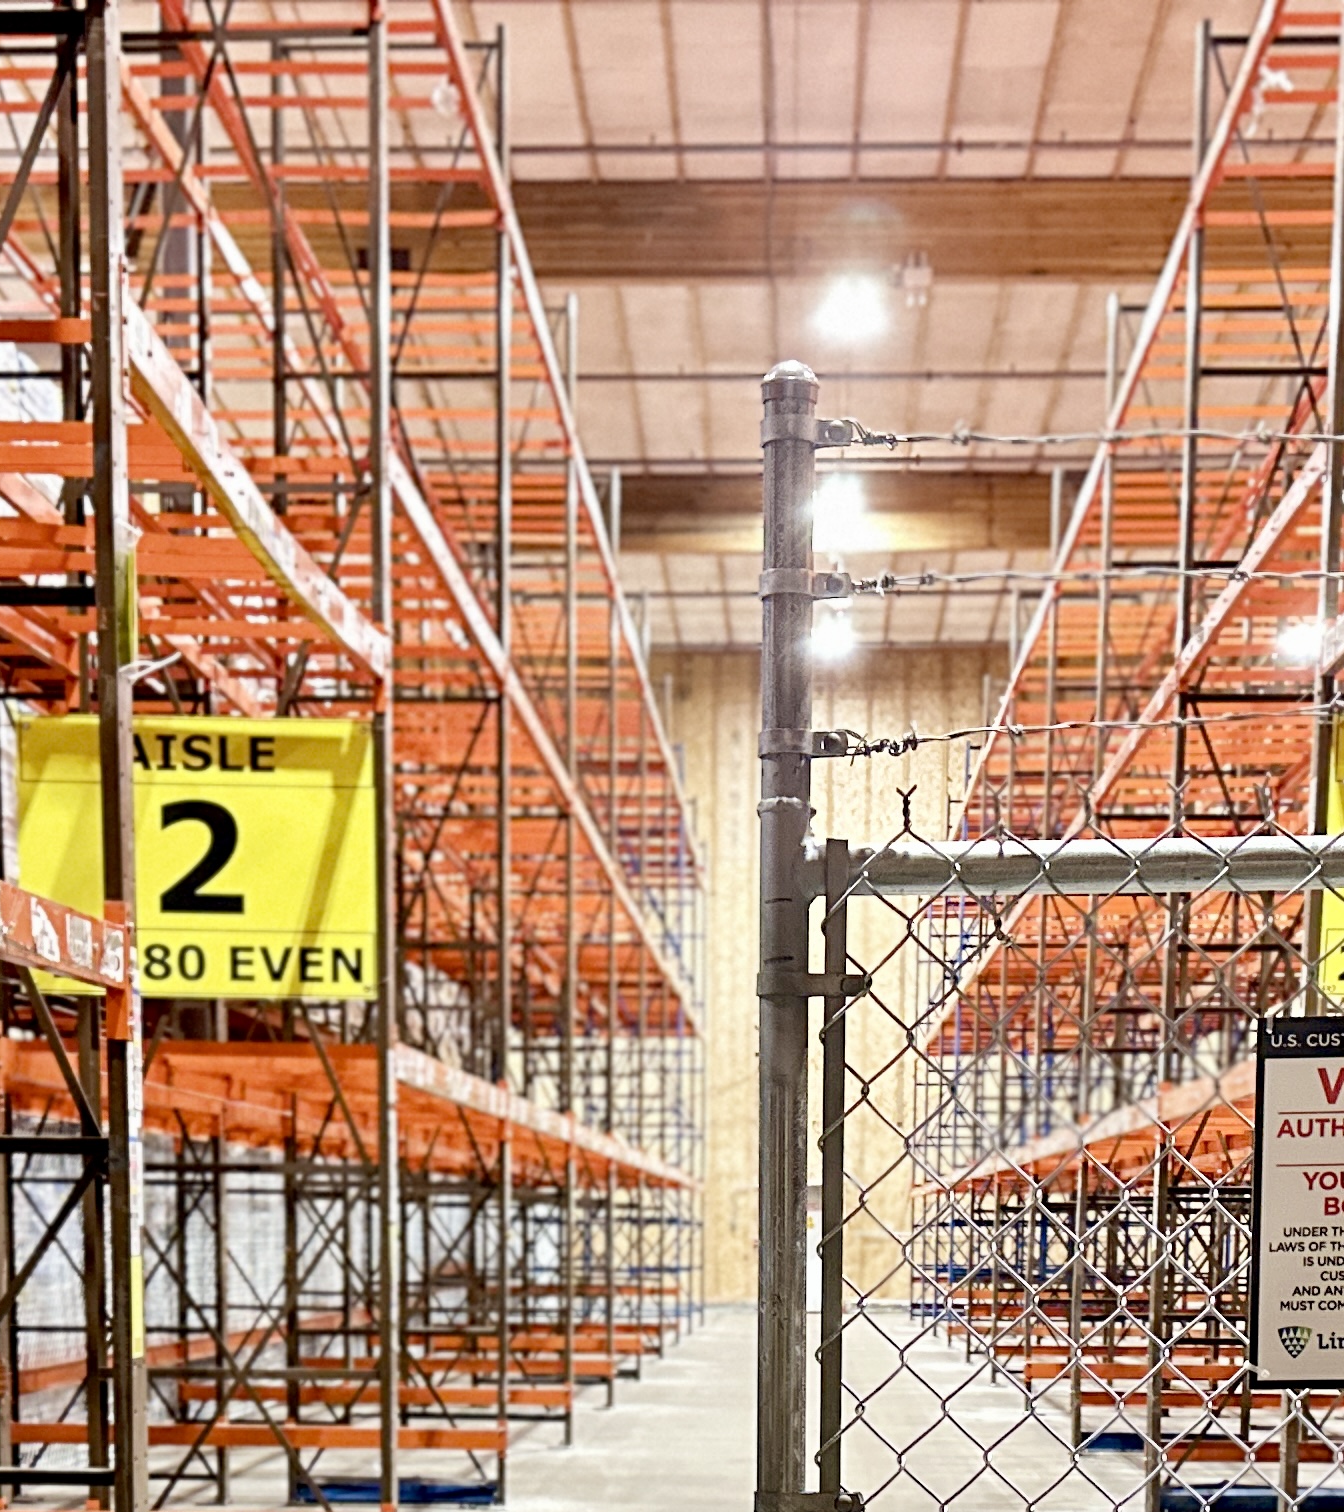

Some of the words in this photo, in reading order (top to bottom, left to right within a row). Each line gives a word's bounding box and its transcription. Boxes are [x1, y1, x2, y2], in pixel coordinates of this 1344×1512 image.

[160, 799, 245, 915] 2
[229, 946, 363, 983] EVEN
[1270, 1034, 1302, 1048] U.S.
[1283, 1226, 1328, 1238] UNDER
[1269, 1242, 1305, 1252] LAWS
[1308, 1241, 1327, 1252] OF
[1303, 1256, 1314, 1267] IS
[1292, 1286, 1321, 1296] AND
[1280, 1300, 1315, 1311] MUST
